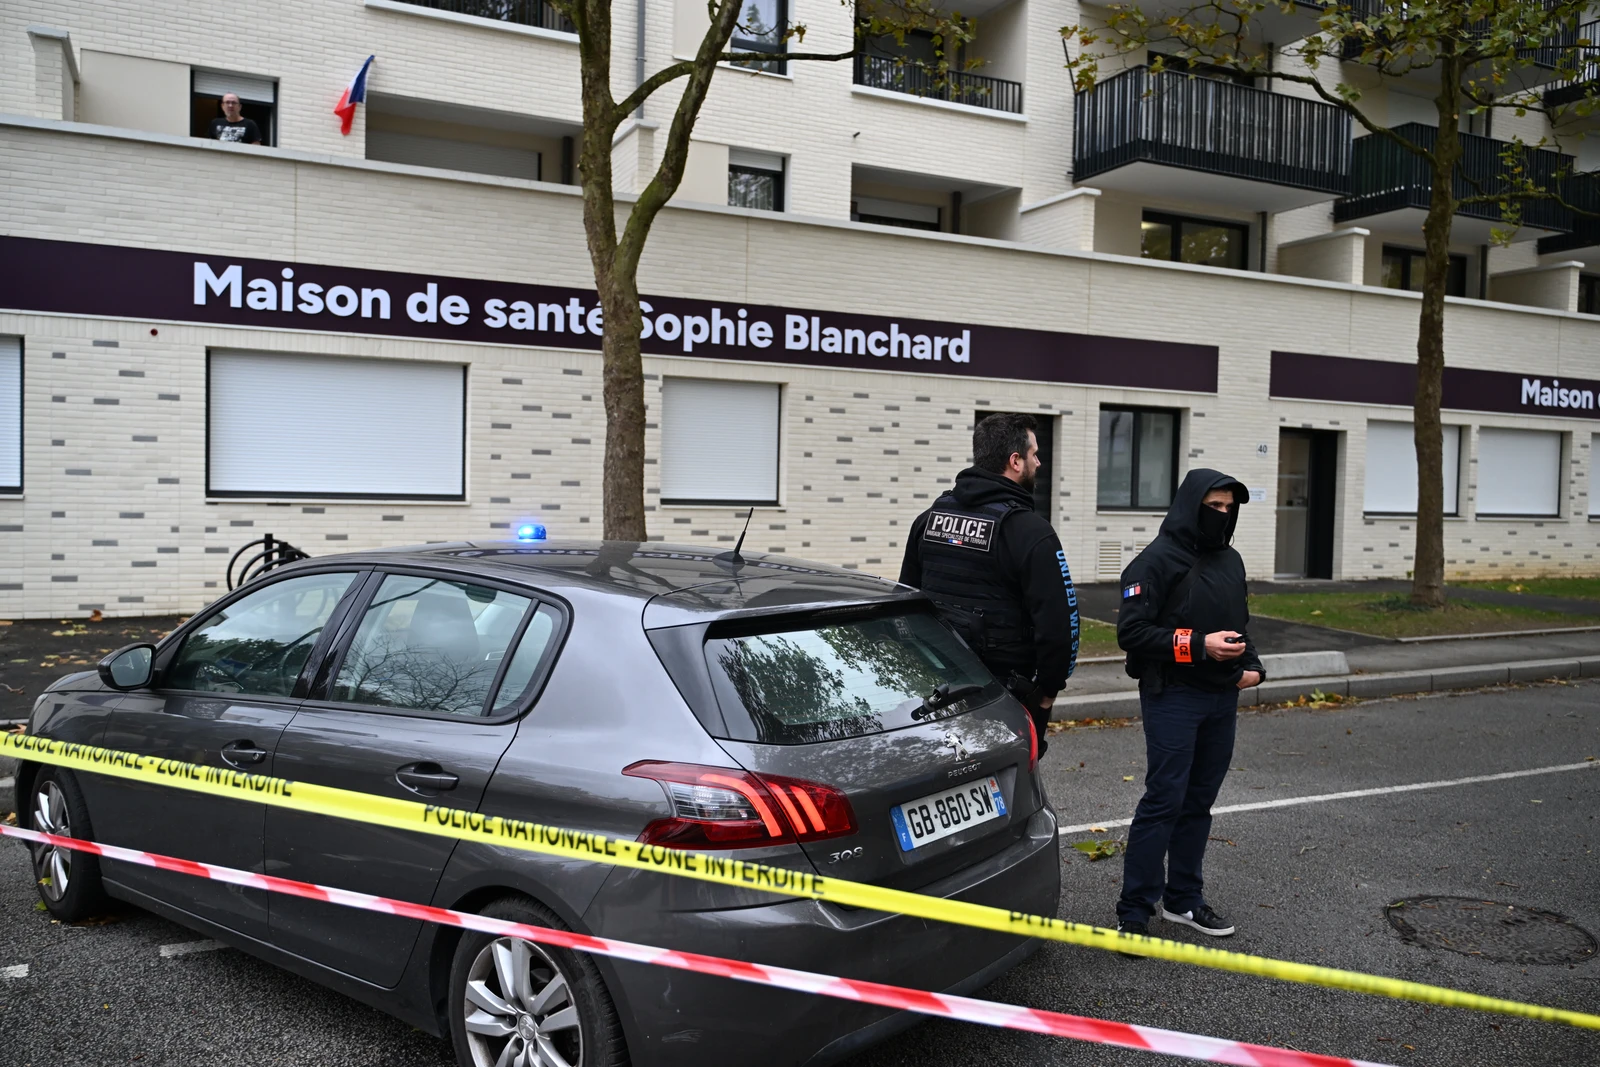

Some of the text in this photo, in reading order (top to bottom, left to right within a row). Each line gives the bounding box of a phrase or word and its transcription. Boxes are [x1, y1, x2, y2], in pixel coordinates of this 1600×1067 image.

[193, 261, 392, 320] Maison
[405, 282, 470, 326] de
[483, 297, 603, 337] santé
[785, 313, 971, 364] Blanchard
[1521, 378, 1594, 410] Maison
[1257, 444, 1268, 454] 40
[931, 514, 988, 539] POLICE
[1056, 549, 1077, 607] UNITED
[1069, 609, 1079, 639] WE
[1179, 629, 1190, 657] POLICE
[947, 762, 982, 778] PEUGEOT
[424, 805, 494, 834] POLICE
[637, 844, 697, 872] ZONE
[705, 856, 825, 895] INTERDITE
[828, 846, 864, 865] 308
